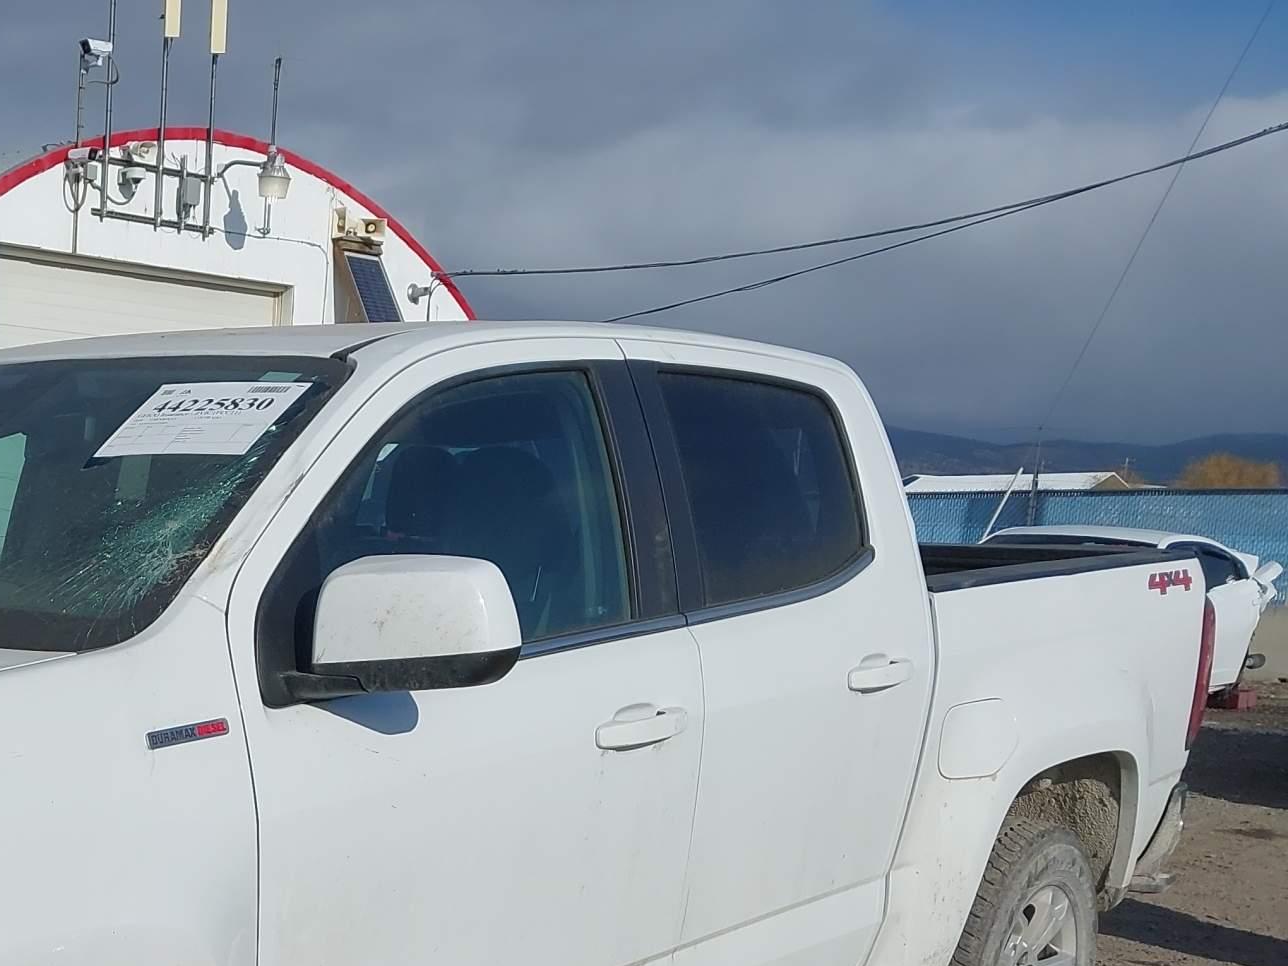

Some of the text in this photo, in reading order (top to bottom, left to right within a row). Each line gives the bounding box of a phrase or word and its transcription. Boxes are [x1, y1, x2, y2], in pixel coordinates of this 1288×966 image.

[153, 397, 275, 413] 44225830
[151, 721, 227, 746] DURAMAX DIESEL
